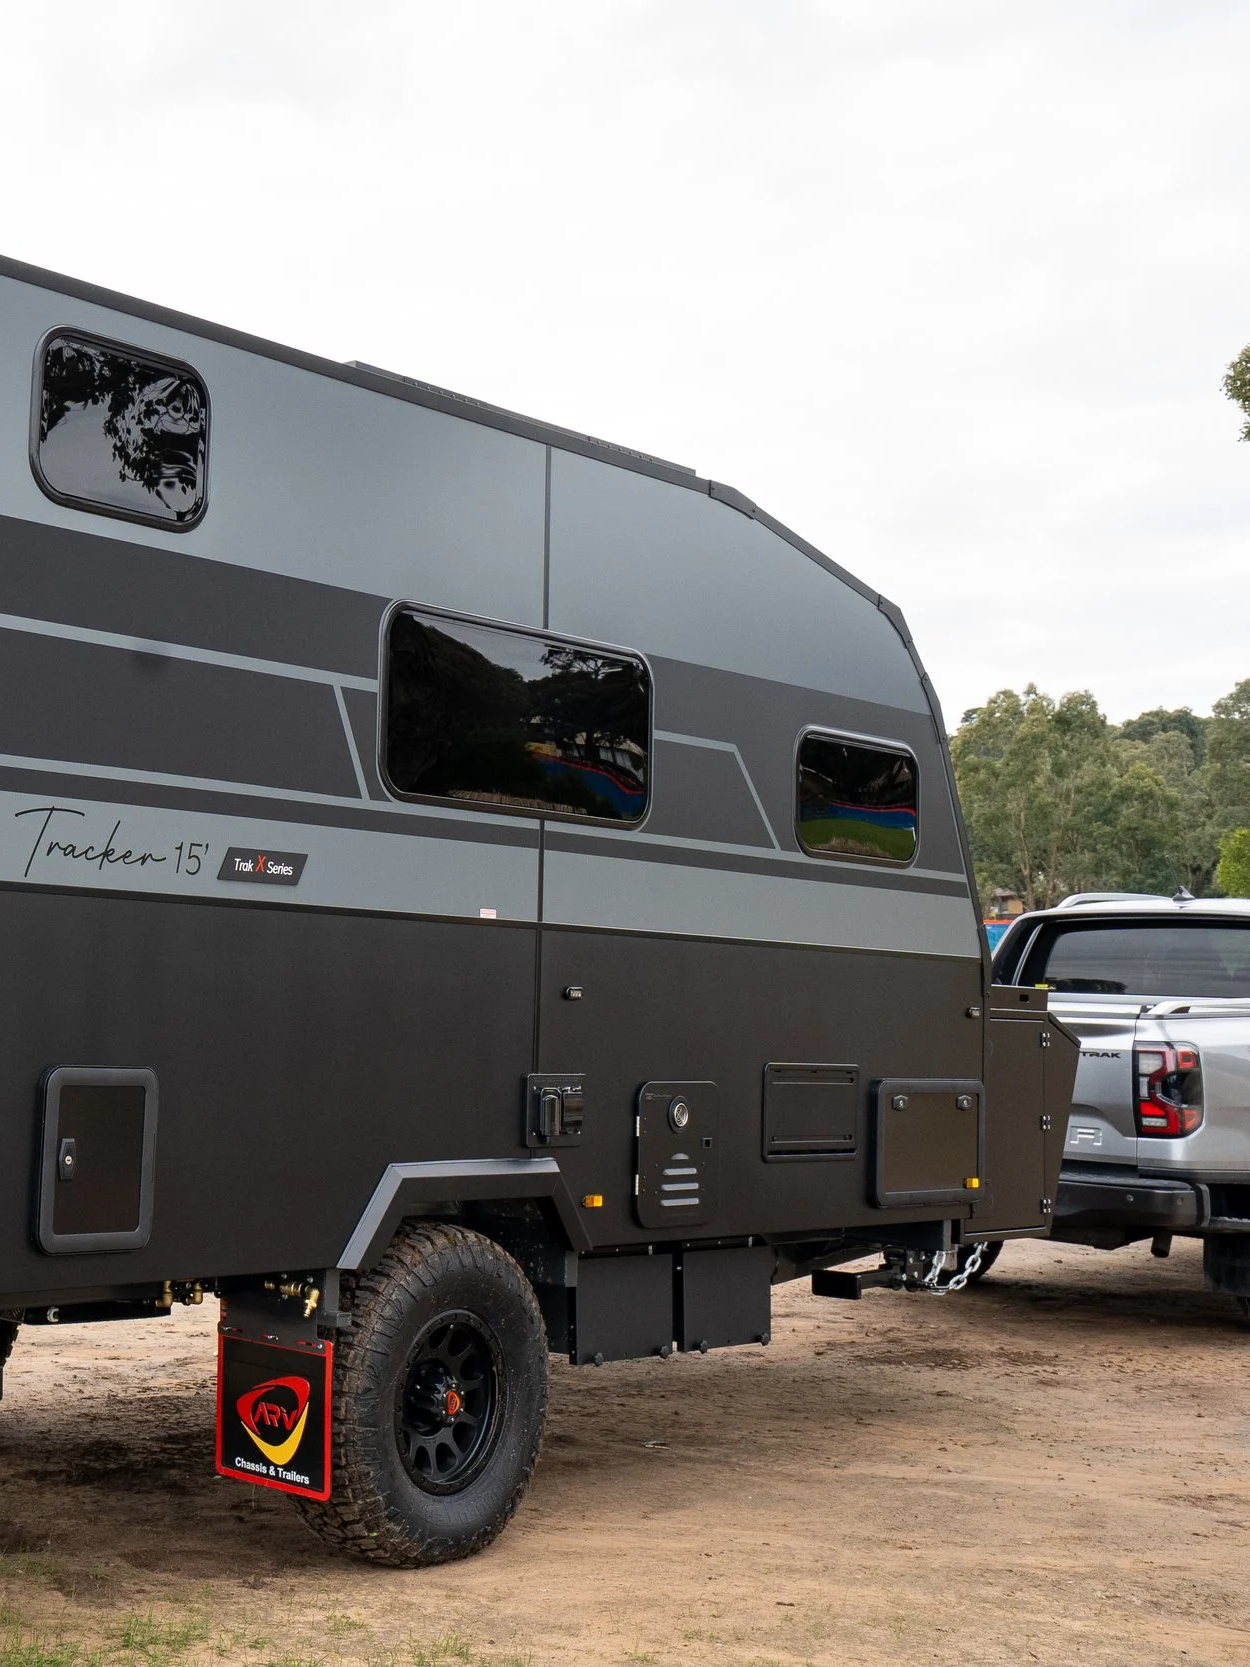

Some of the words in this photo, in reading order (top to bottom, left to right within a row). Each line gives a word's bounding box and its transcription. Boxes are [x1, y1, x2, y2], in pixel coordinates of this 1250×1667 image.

[14, 805, 167, 878] Tracker
[174, 841, 209, 876] 15'
[234, 857, 254, 873] Trak
[255, 855, 265, 873] X
[266, 861, 294, 876] Series
[235, 1457, 267, 1474] Chassis
[269, 1465, 276, 1477] &
[277, 1468, 310, 1485] Trailers
